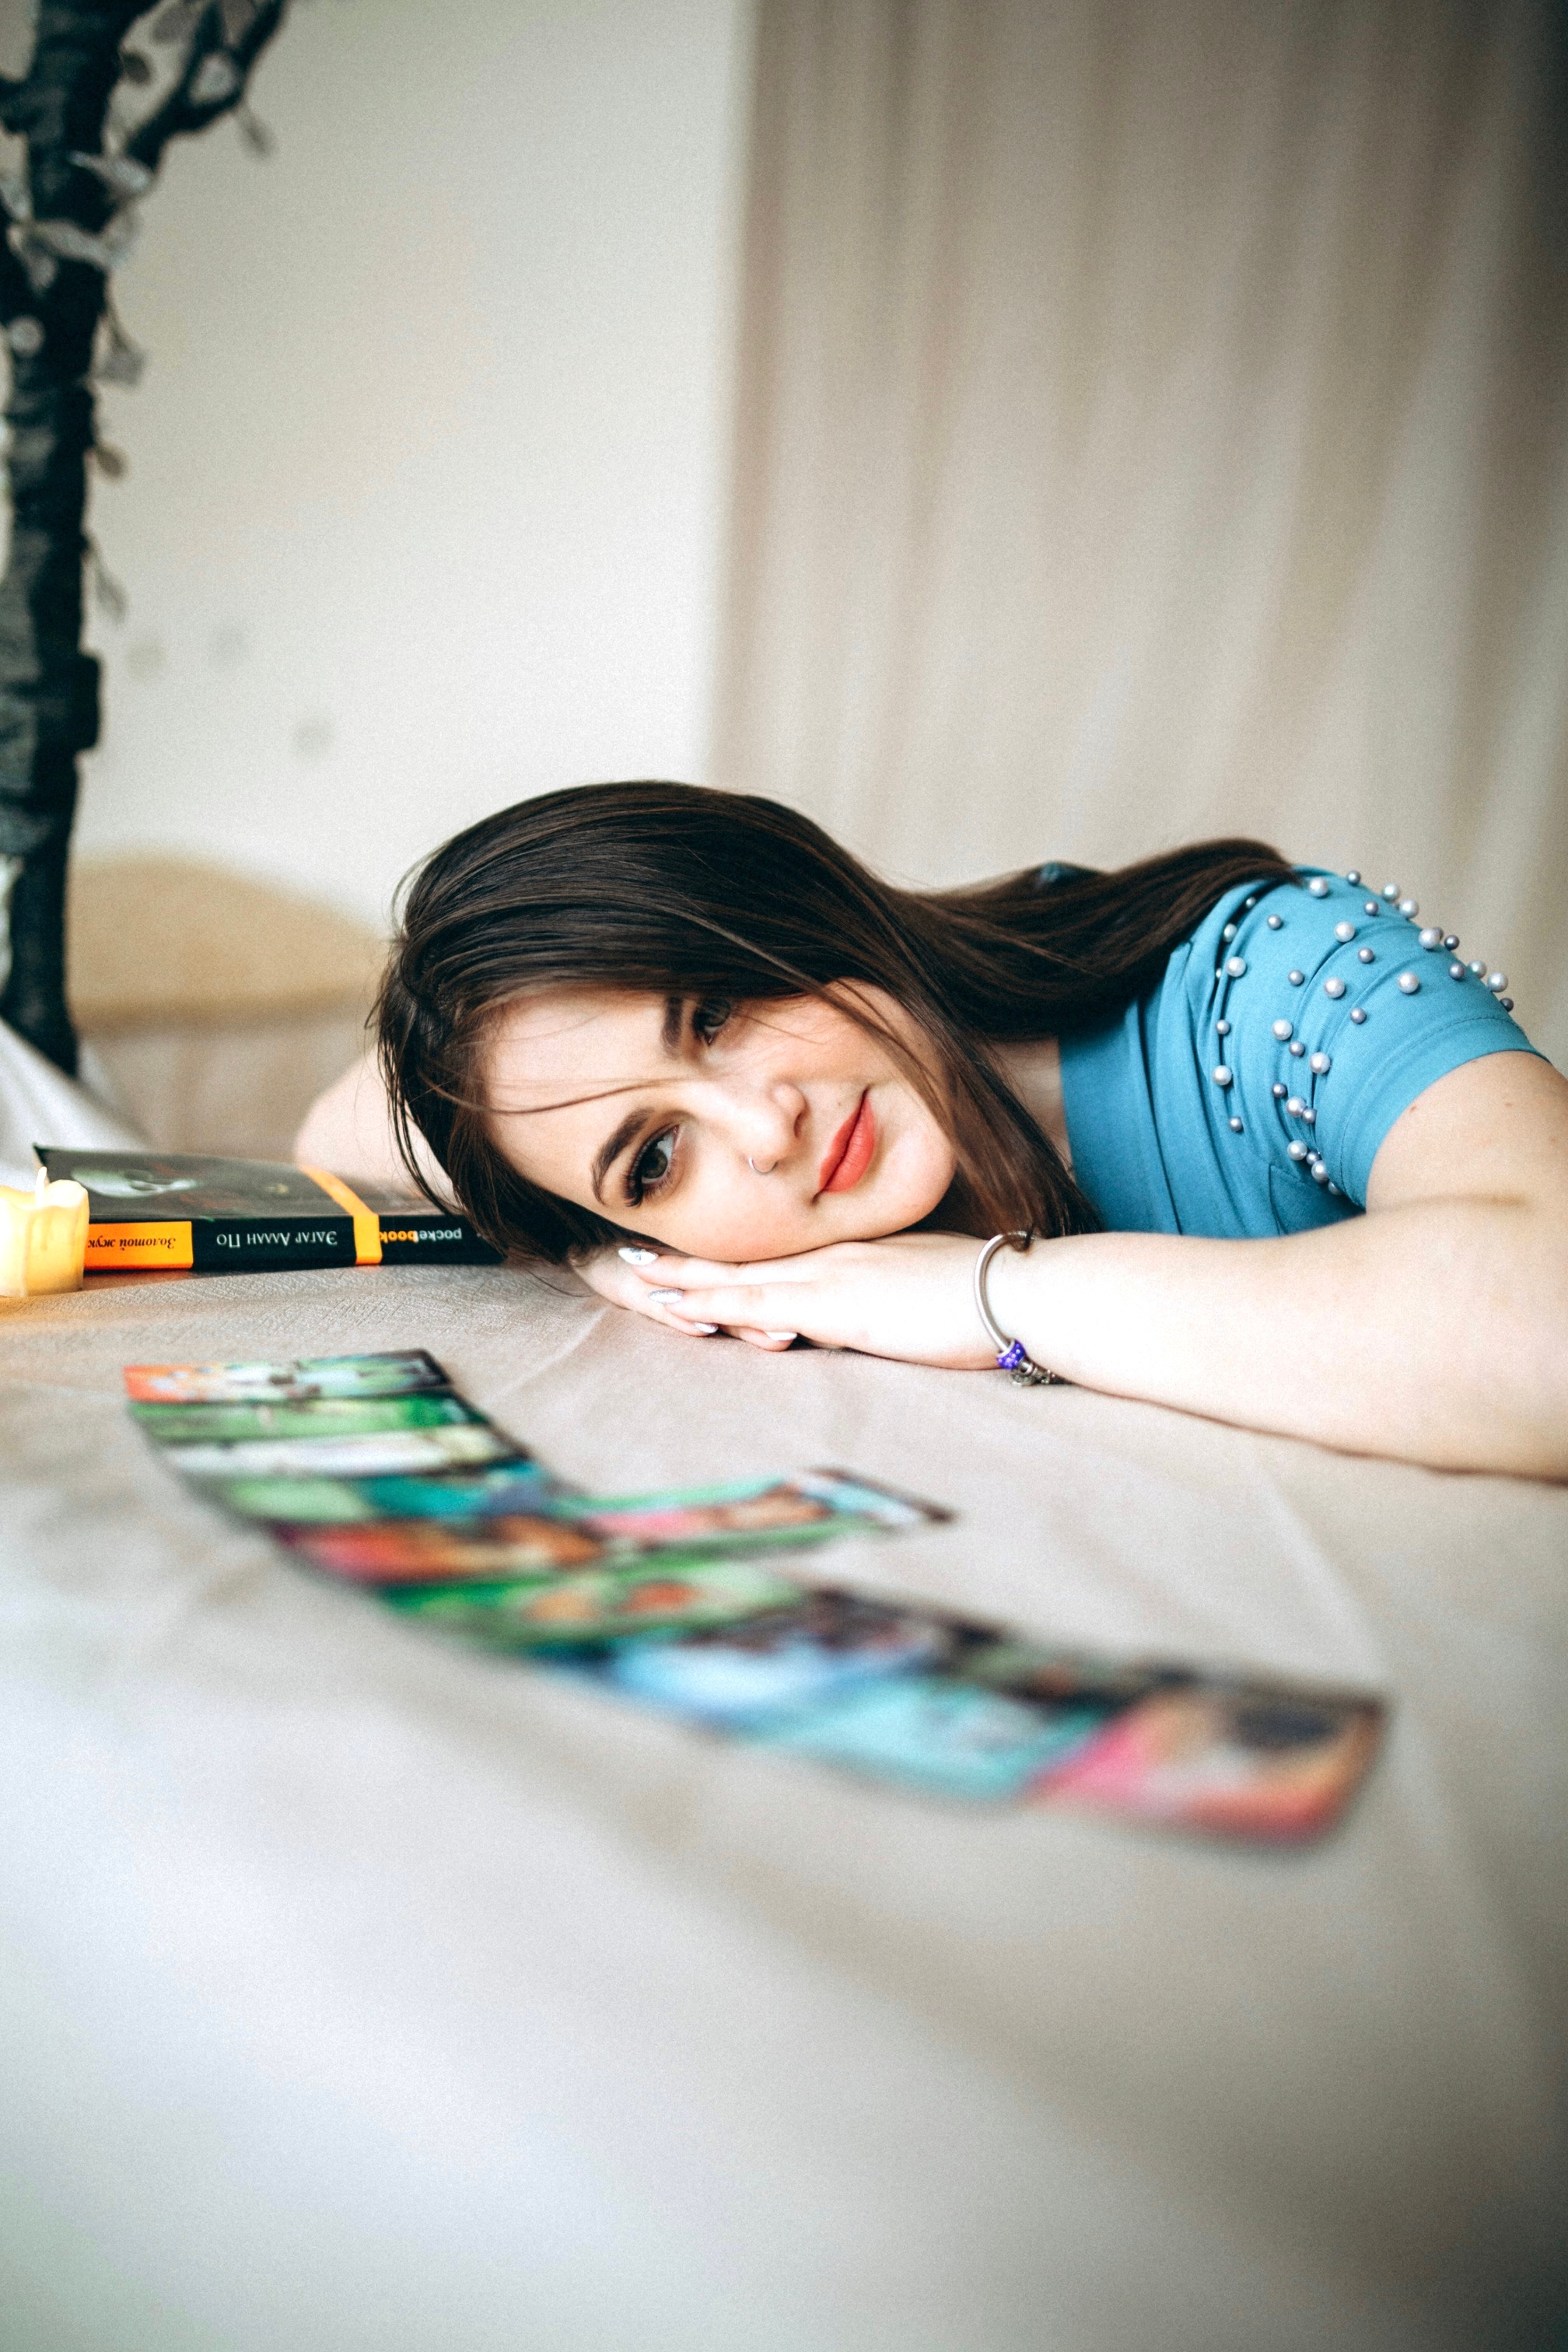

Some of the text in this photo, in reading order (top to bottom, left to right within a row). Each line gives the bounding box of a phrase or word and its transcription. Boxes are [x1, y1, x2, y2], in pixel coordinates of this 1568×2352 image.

[87, 1235, 177, 1251] Золотой жук
[379, 1227, 463, 1243] pocketbook
